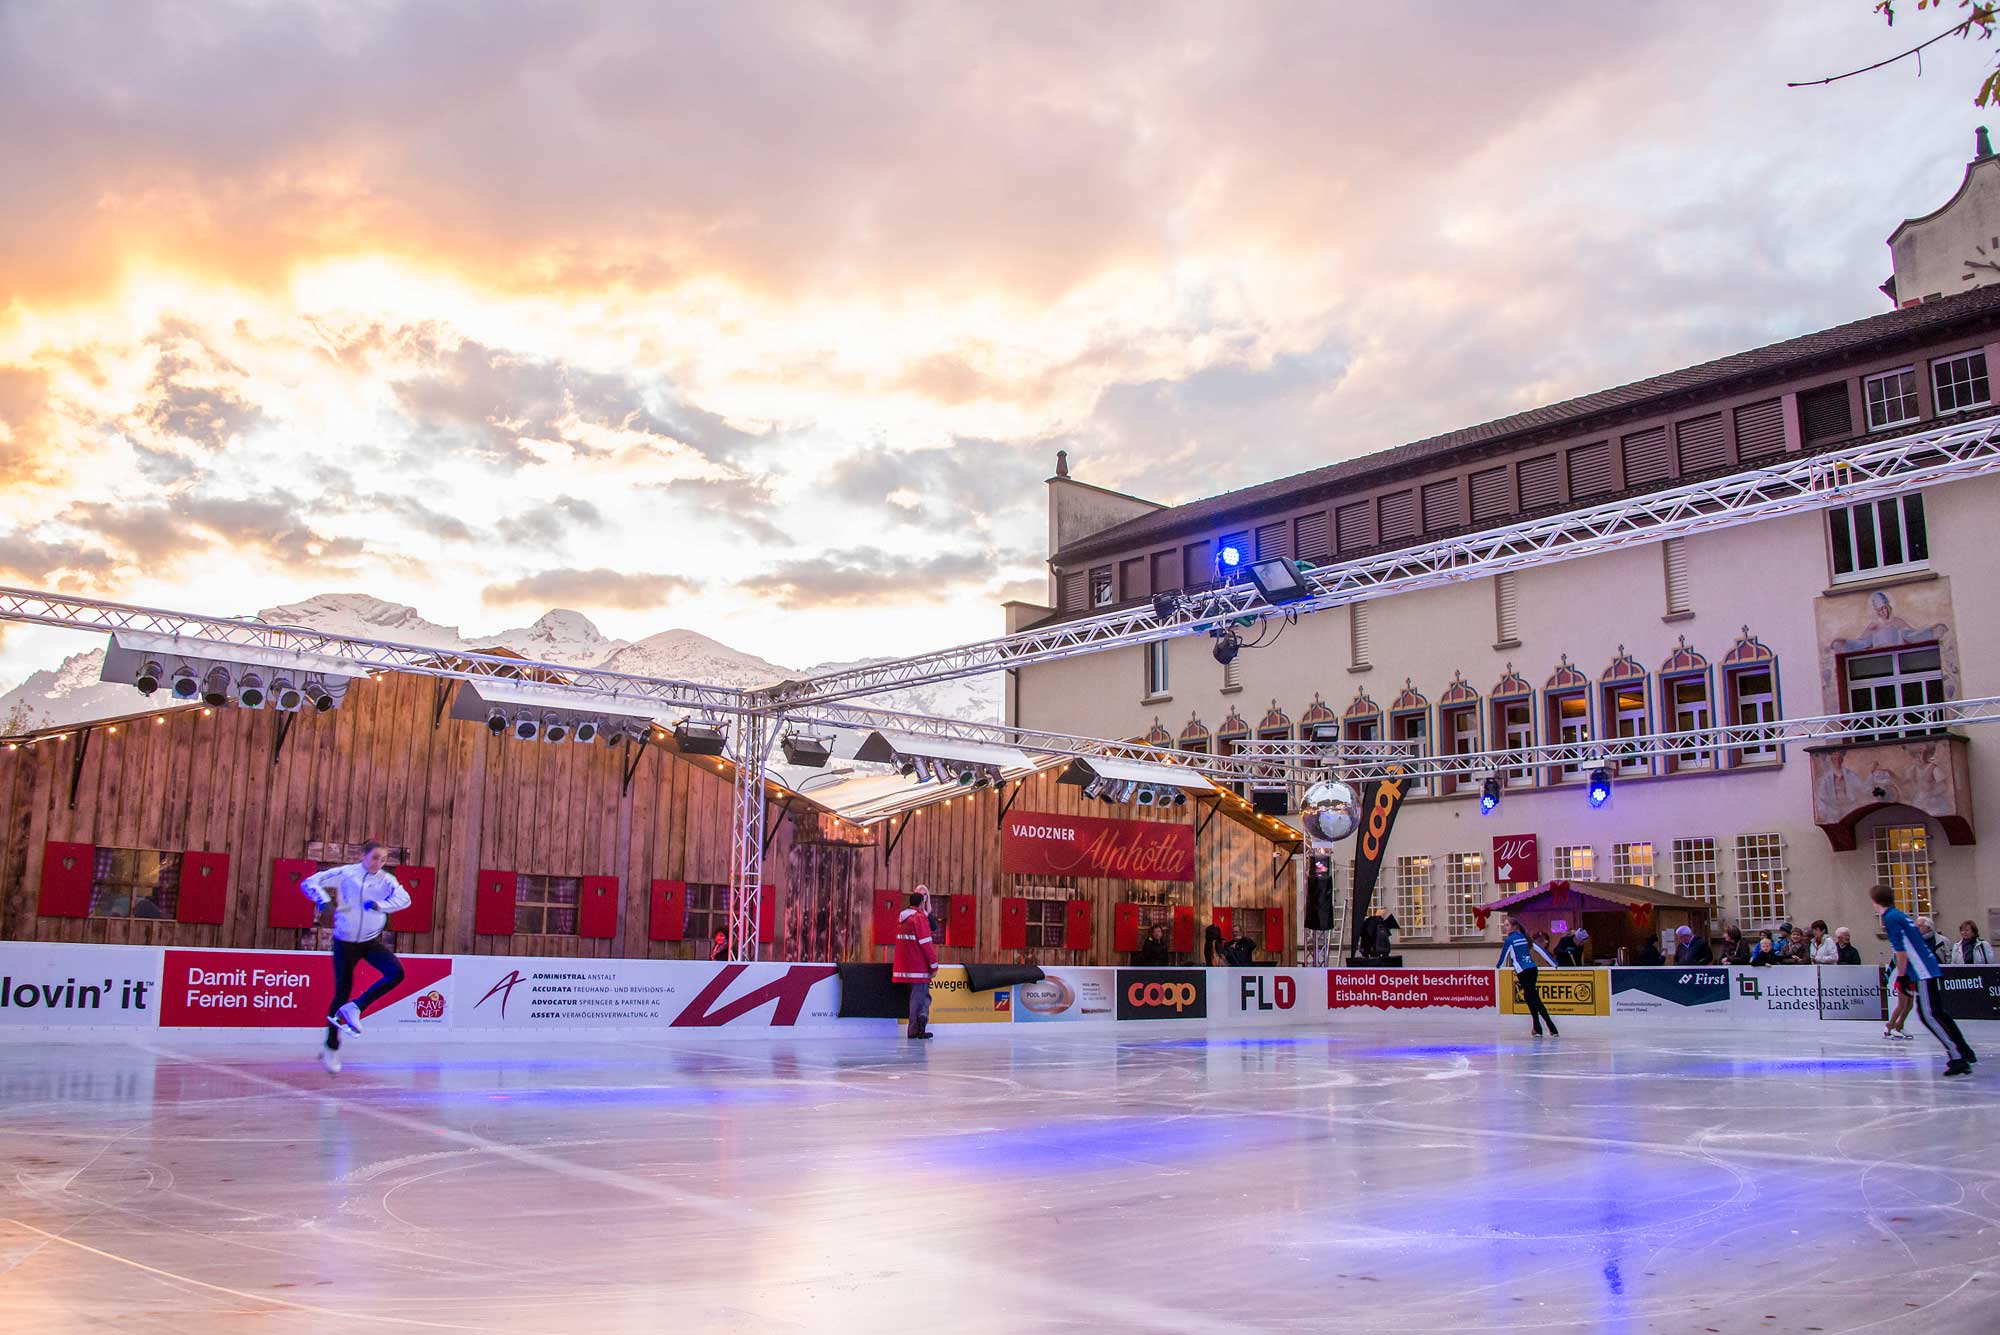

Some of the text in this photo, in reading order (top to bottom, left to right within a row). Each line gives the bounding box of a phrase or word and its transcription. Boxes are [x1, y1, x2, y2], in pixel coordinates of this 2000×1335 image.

[1363, 763, 1404, 861] coop
[1011, 824, 1076, 841] VADOZNER
[1494, 839, 1535, 861] WC
[188, 967, 310, 988] Damit Ferien
[1335, 974, 1490, 988] Reinold Ospelt beschriftet
[1694, 973, 1726, 985] First
[1944, 976, 1984, 991] connect
[0, 976, 113, 1009] lovin'
[1127, 982, 1197, 1012] coop
[1335, 990, 1428, 1002] Eisbahn-Banden
[1766, 985, 1899, 998] Liechtensteinische
[186, 989, 298, 1009] Ferien sind.
[412, 1000, 448, 1010] TRAVEL
[1767, 998, 1851, 1011] Landesbank
[422, 1010, 441, 1018] NET
[561, 1010, 649, 1018] VERMÖGENSVERWALTUNG
